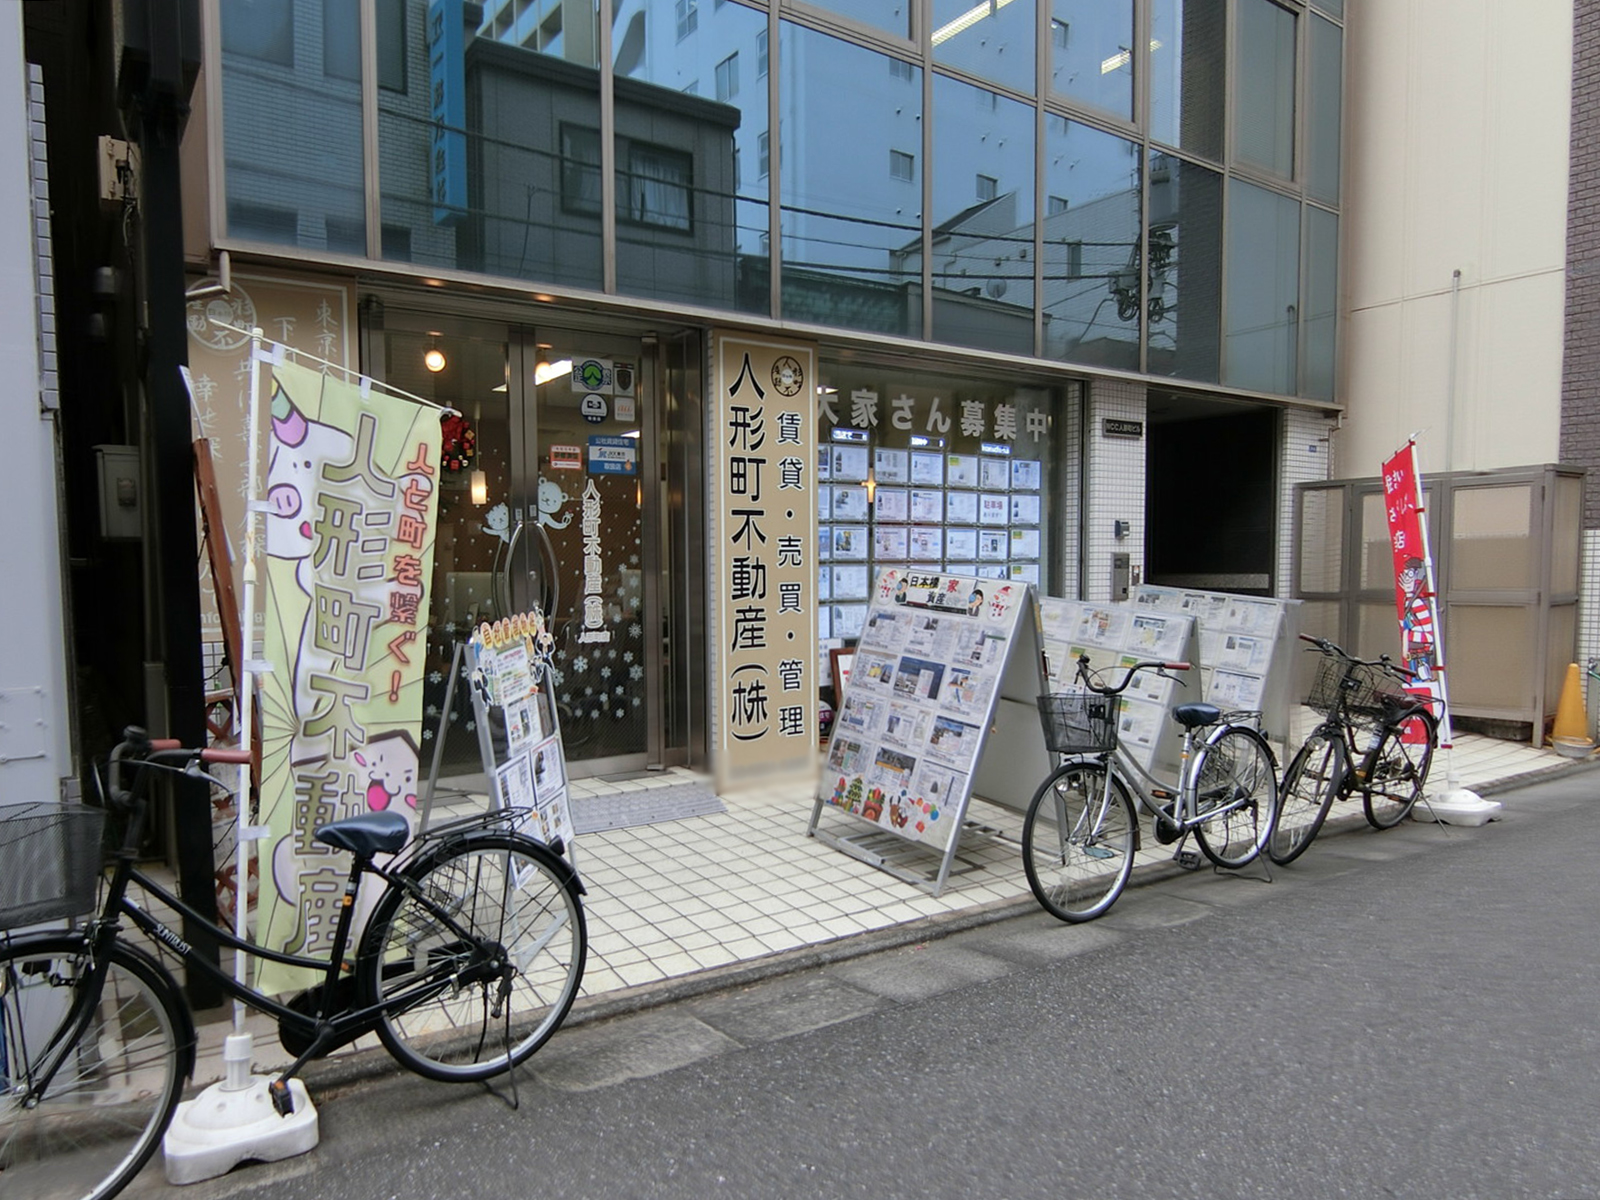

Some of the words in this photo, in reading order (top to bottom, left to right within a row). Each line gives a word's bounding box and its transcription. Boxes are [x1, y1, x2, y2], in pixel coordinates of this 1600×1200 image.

[284, 412, 396, 954] 人形町不動産
[388, 442, 435, 703] 人と町を繋ぐ!
[728, 351, 769, 741] 人形町不動産(株)
[776, 411, 804, 736] 賃貸・売買・管理
